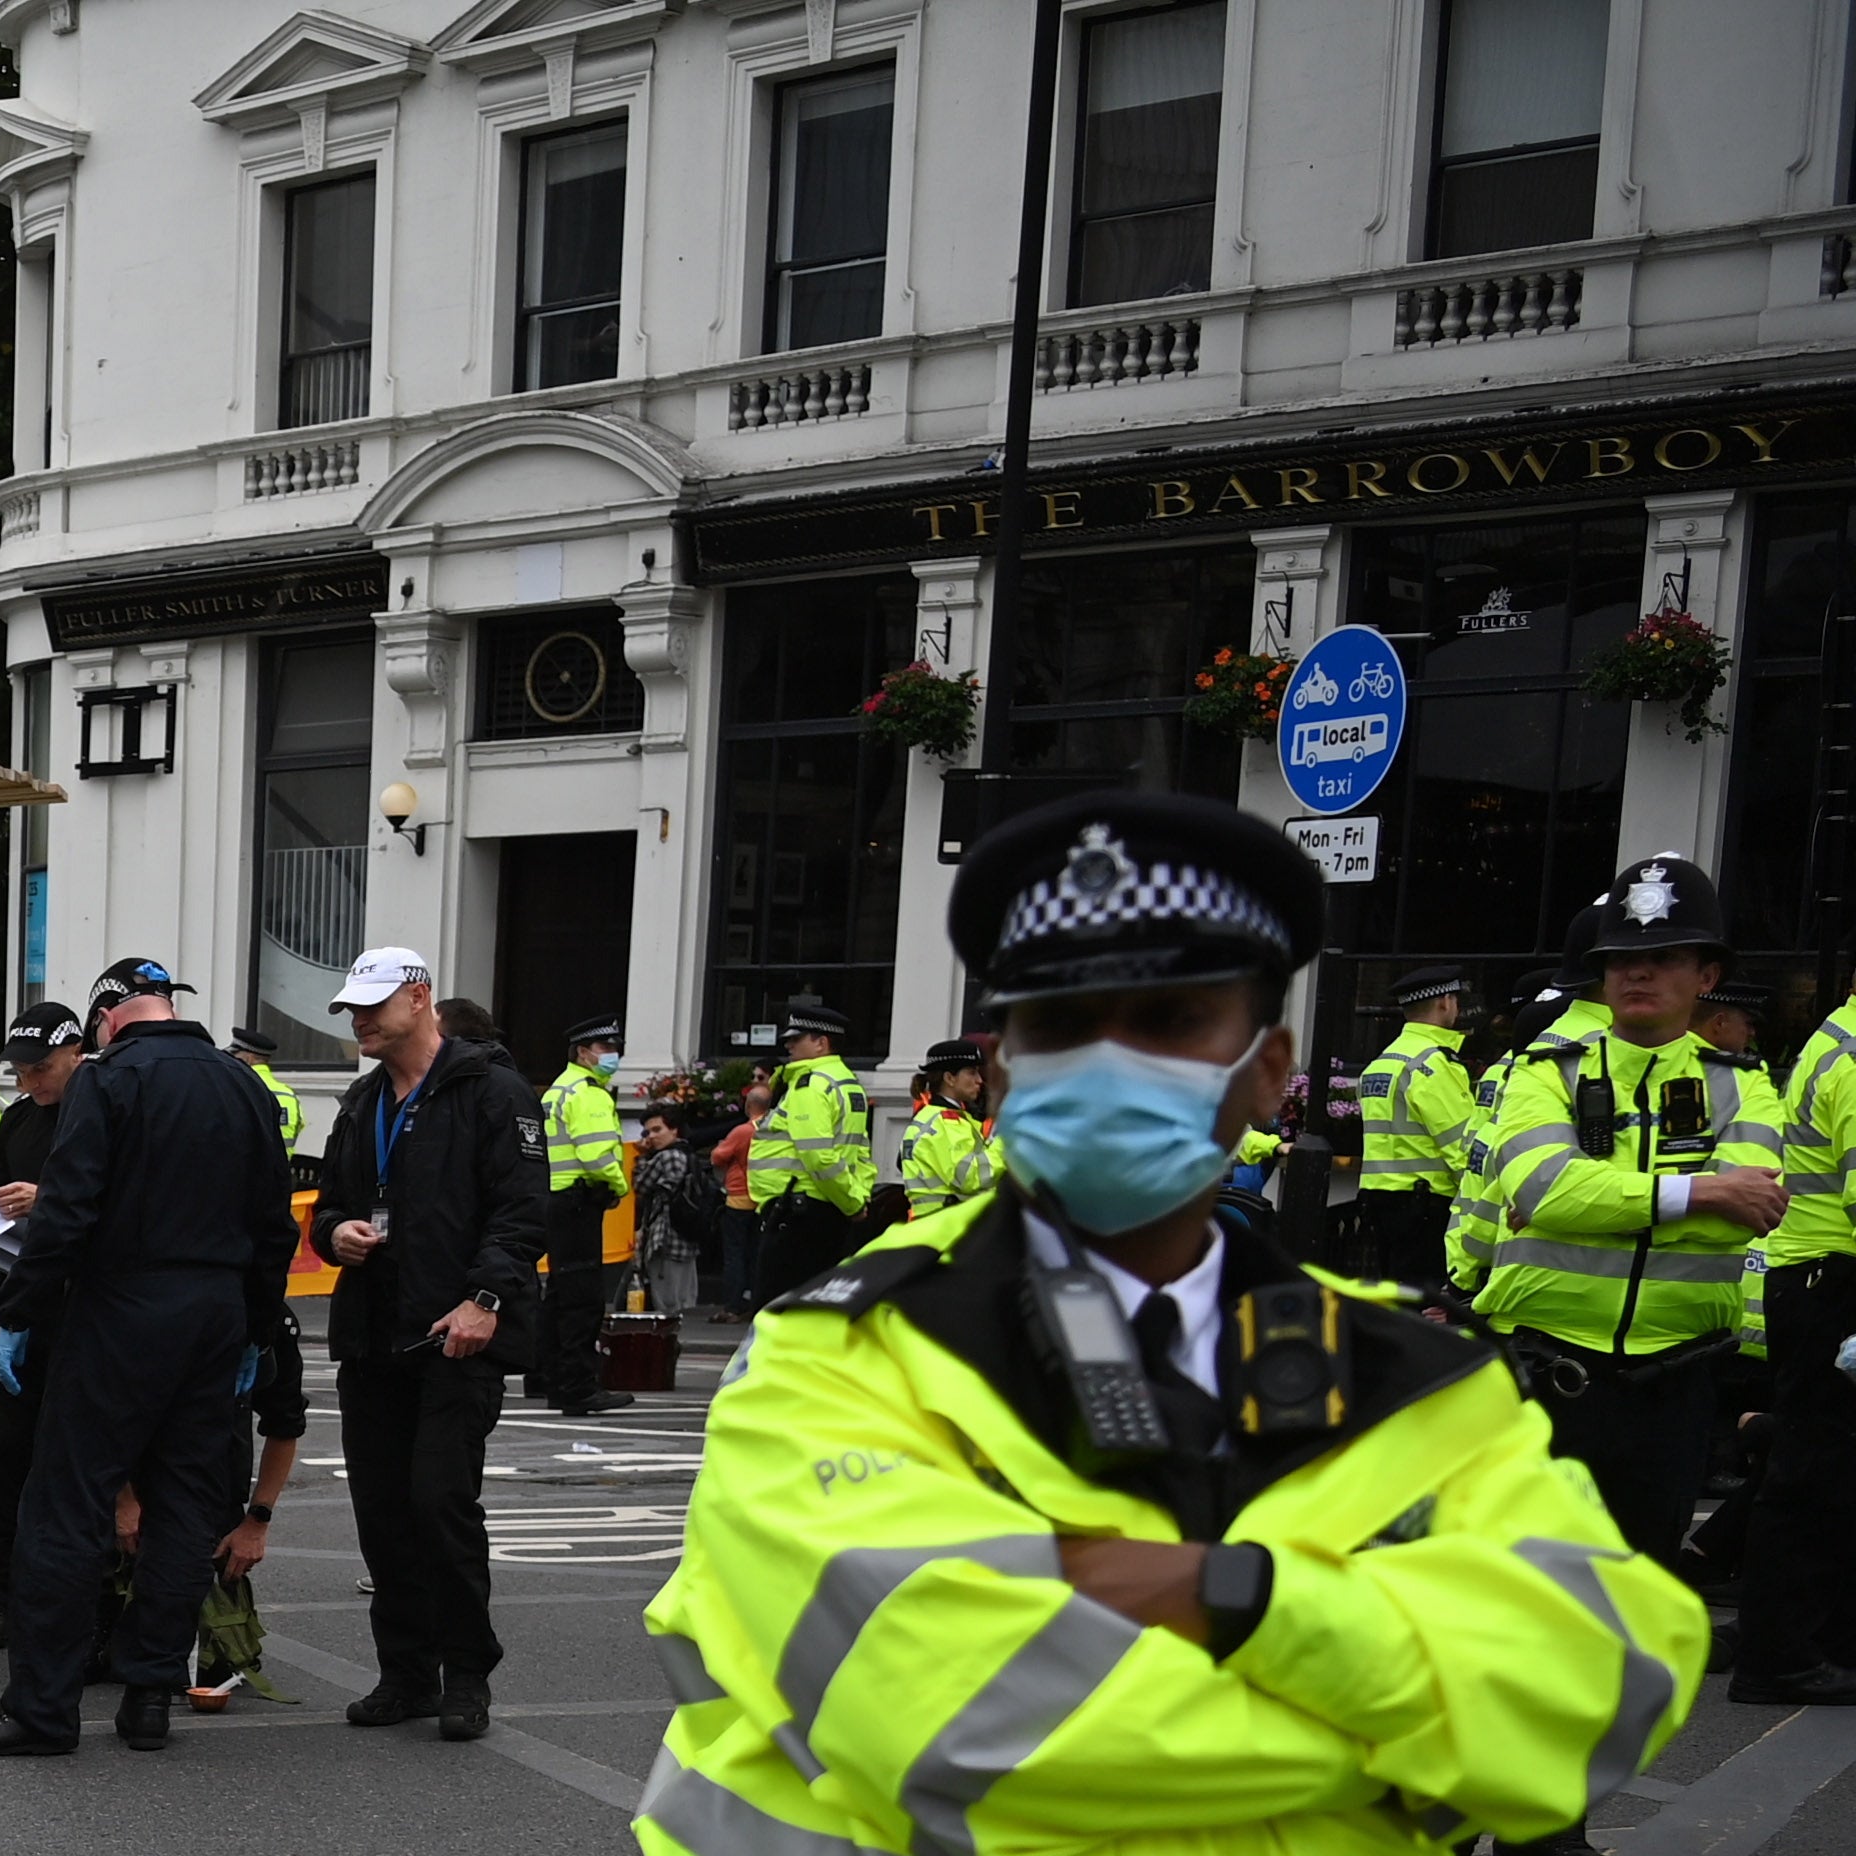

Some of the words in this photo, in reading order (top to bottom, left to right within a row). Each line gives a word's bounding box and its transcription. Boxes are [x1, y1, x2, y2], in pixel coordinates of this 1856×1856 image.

[913, 490, 1084, 541] THE
[1147, 418, 1801, 520] BARROWBOY
[165, 594, 245, 618] SMITH
[251, 596, 265, 609] &
[273, 579, 379, 606] TURNER
[1461, 613, 1528, 630] FULLER'S
[1322, 720, 1366, 746] local
[1318, 772, 1353, 797] taxi
[1298, 829, 1330, 849] Mon
[1343, 826, 1364, 847] Fri
